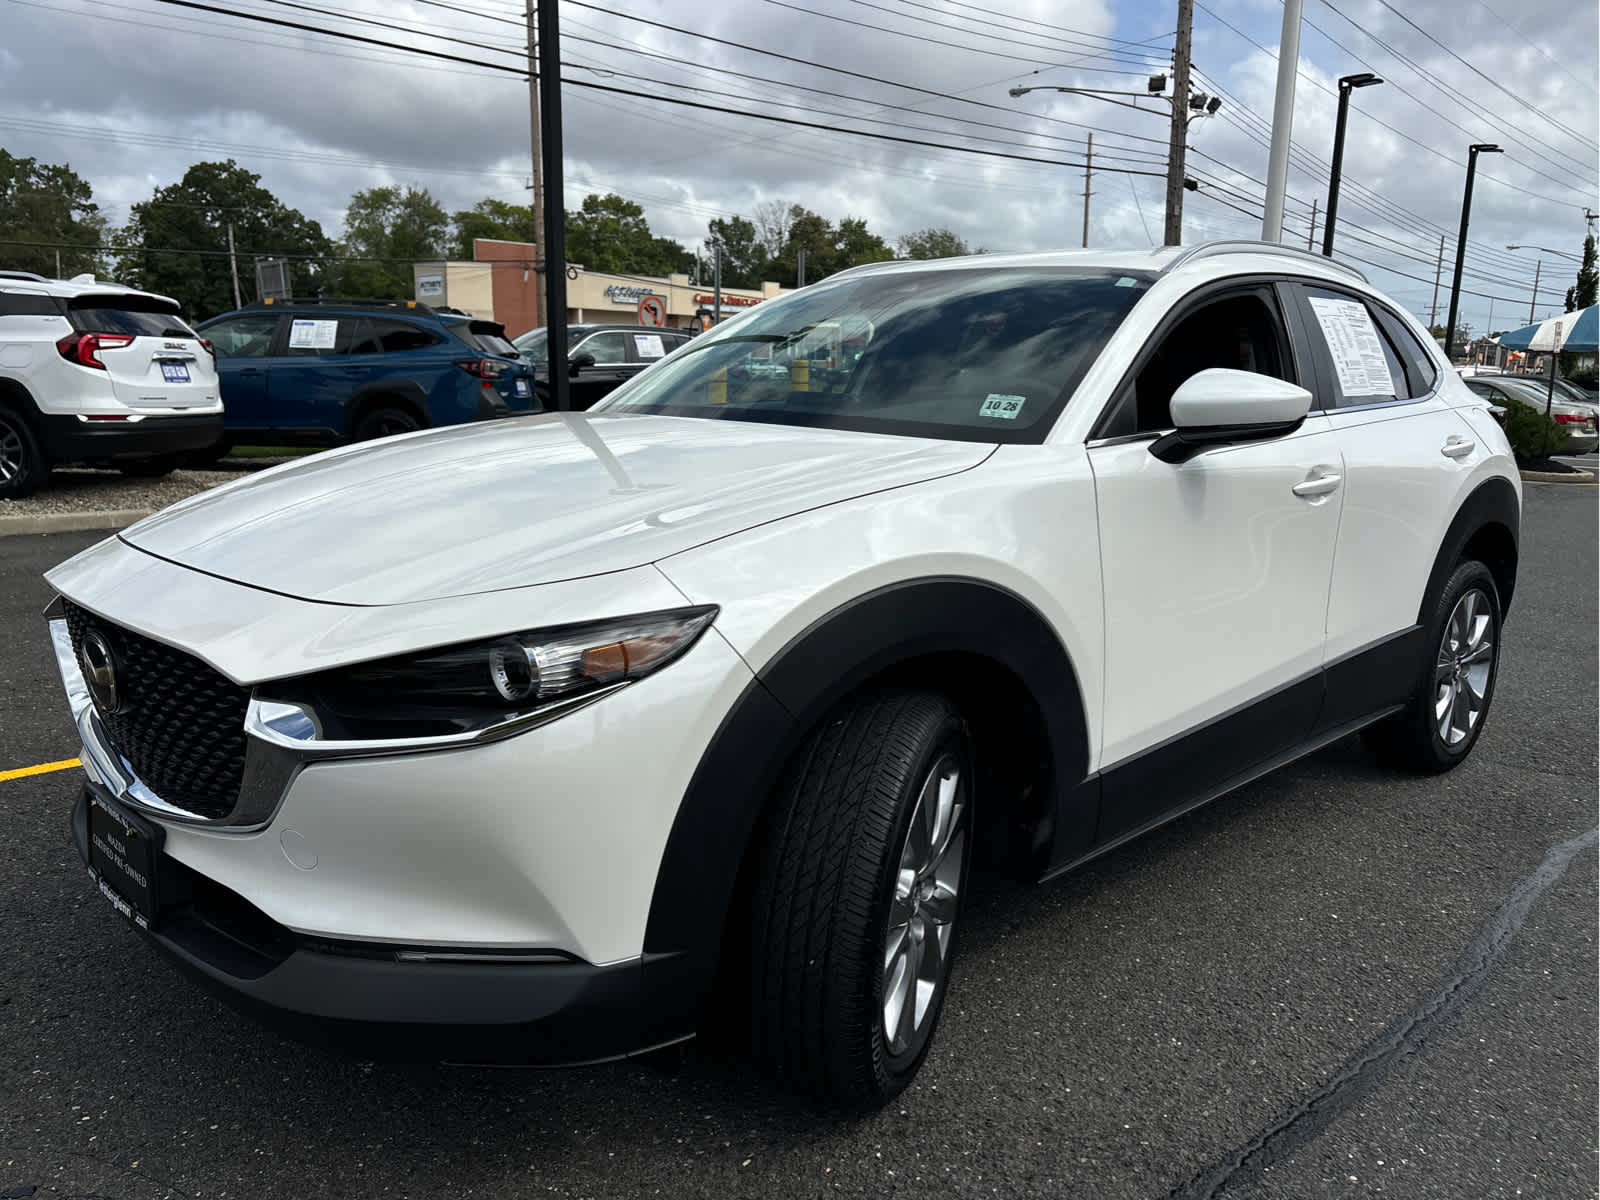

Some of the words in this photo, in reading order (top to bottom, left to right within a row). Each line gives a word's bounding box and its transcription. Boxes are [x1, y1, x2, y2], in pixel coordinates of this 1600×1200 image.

[985, 401, 1001, 410] 10
[1003, 402, 1018, 411] 28
[107, 832, 127, 857] MAZDA
[114, 853, 147, 888] PRE-OWNED
